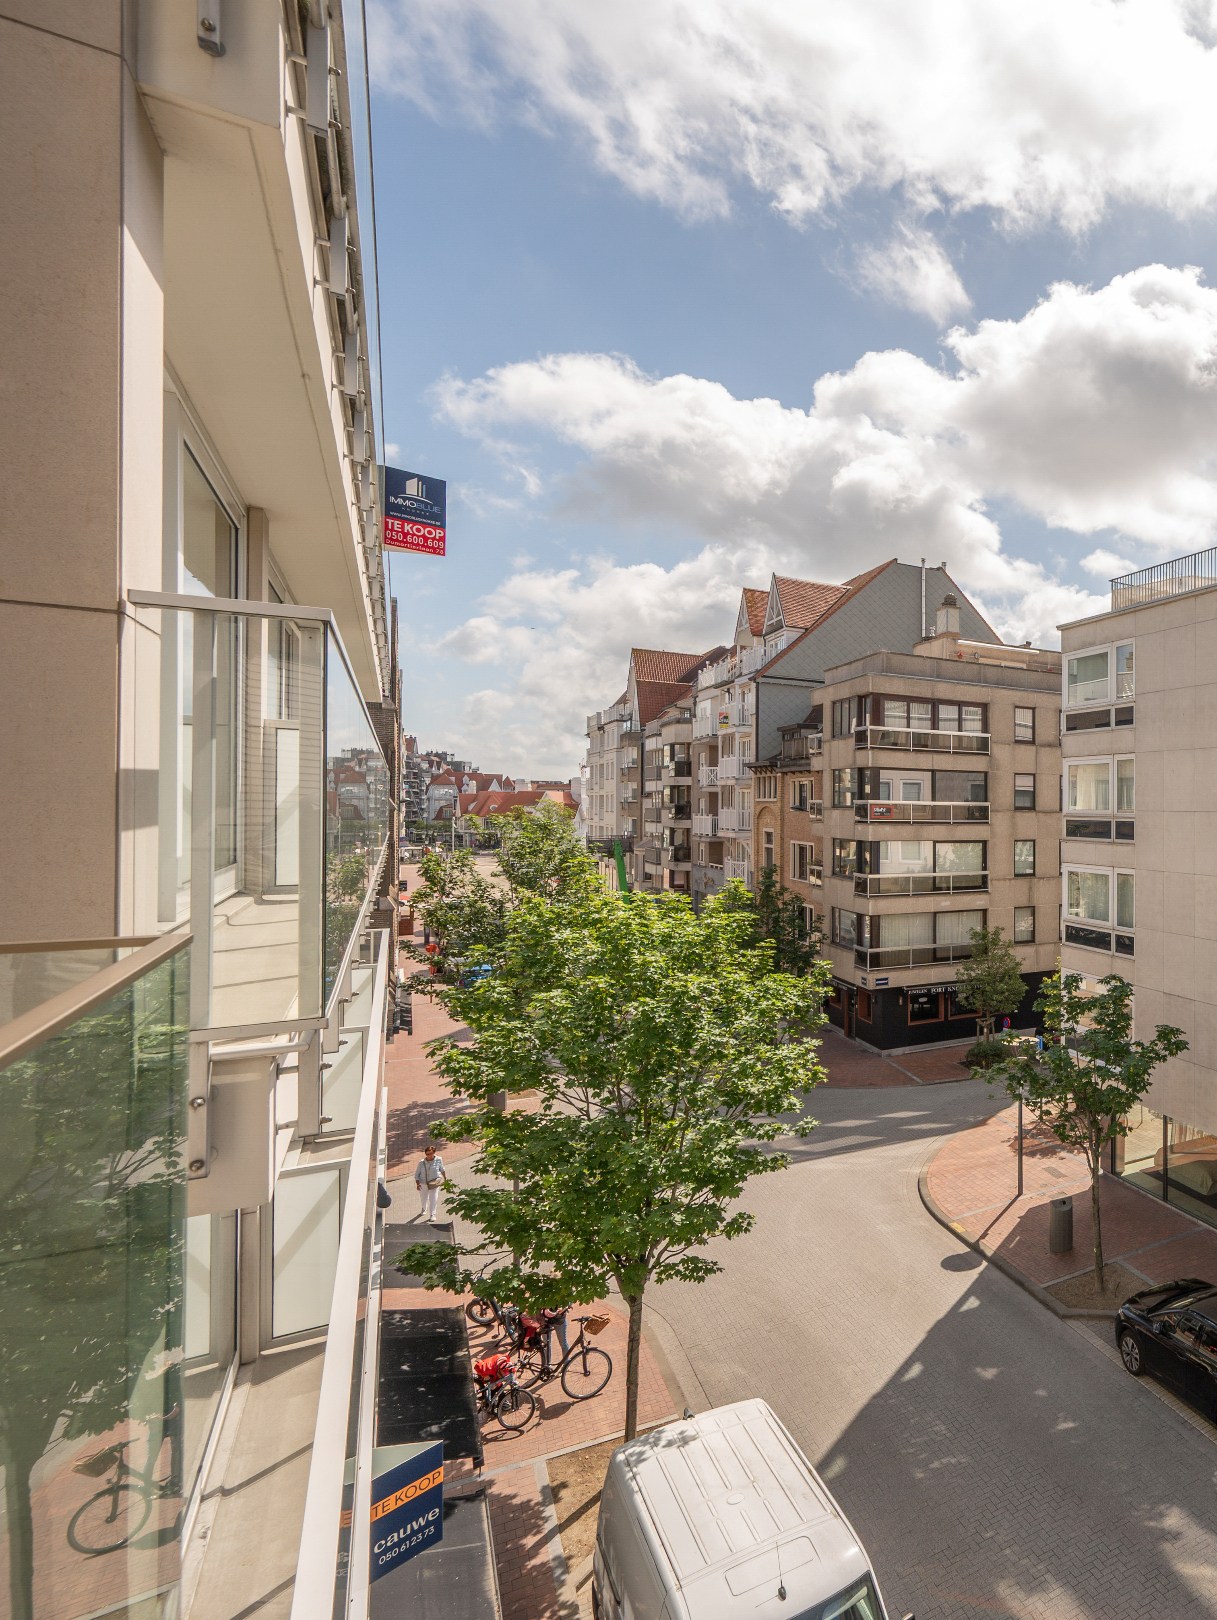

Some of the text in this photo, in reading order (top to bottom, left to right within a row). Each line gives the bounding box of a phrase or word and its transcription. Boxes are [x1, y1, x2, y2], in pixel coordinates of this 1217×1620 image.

[389, 496, 441, 514] IMMOBLUE
[386, 518, 445, 540] TE KOOP
[386, 530, 445, 549] 050.600.609
[372, 1471, 441, 1518] TE KOOP
[373, 1507, 440, 1554] cauwe
[378, 1548, 399, 1565] 050
